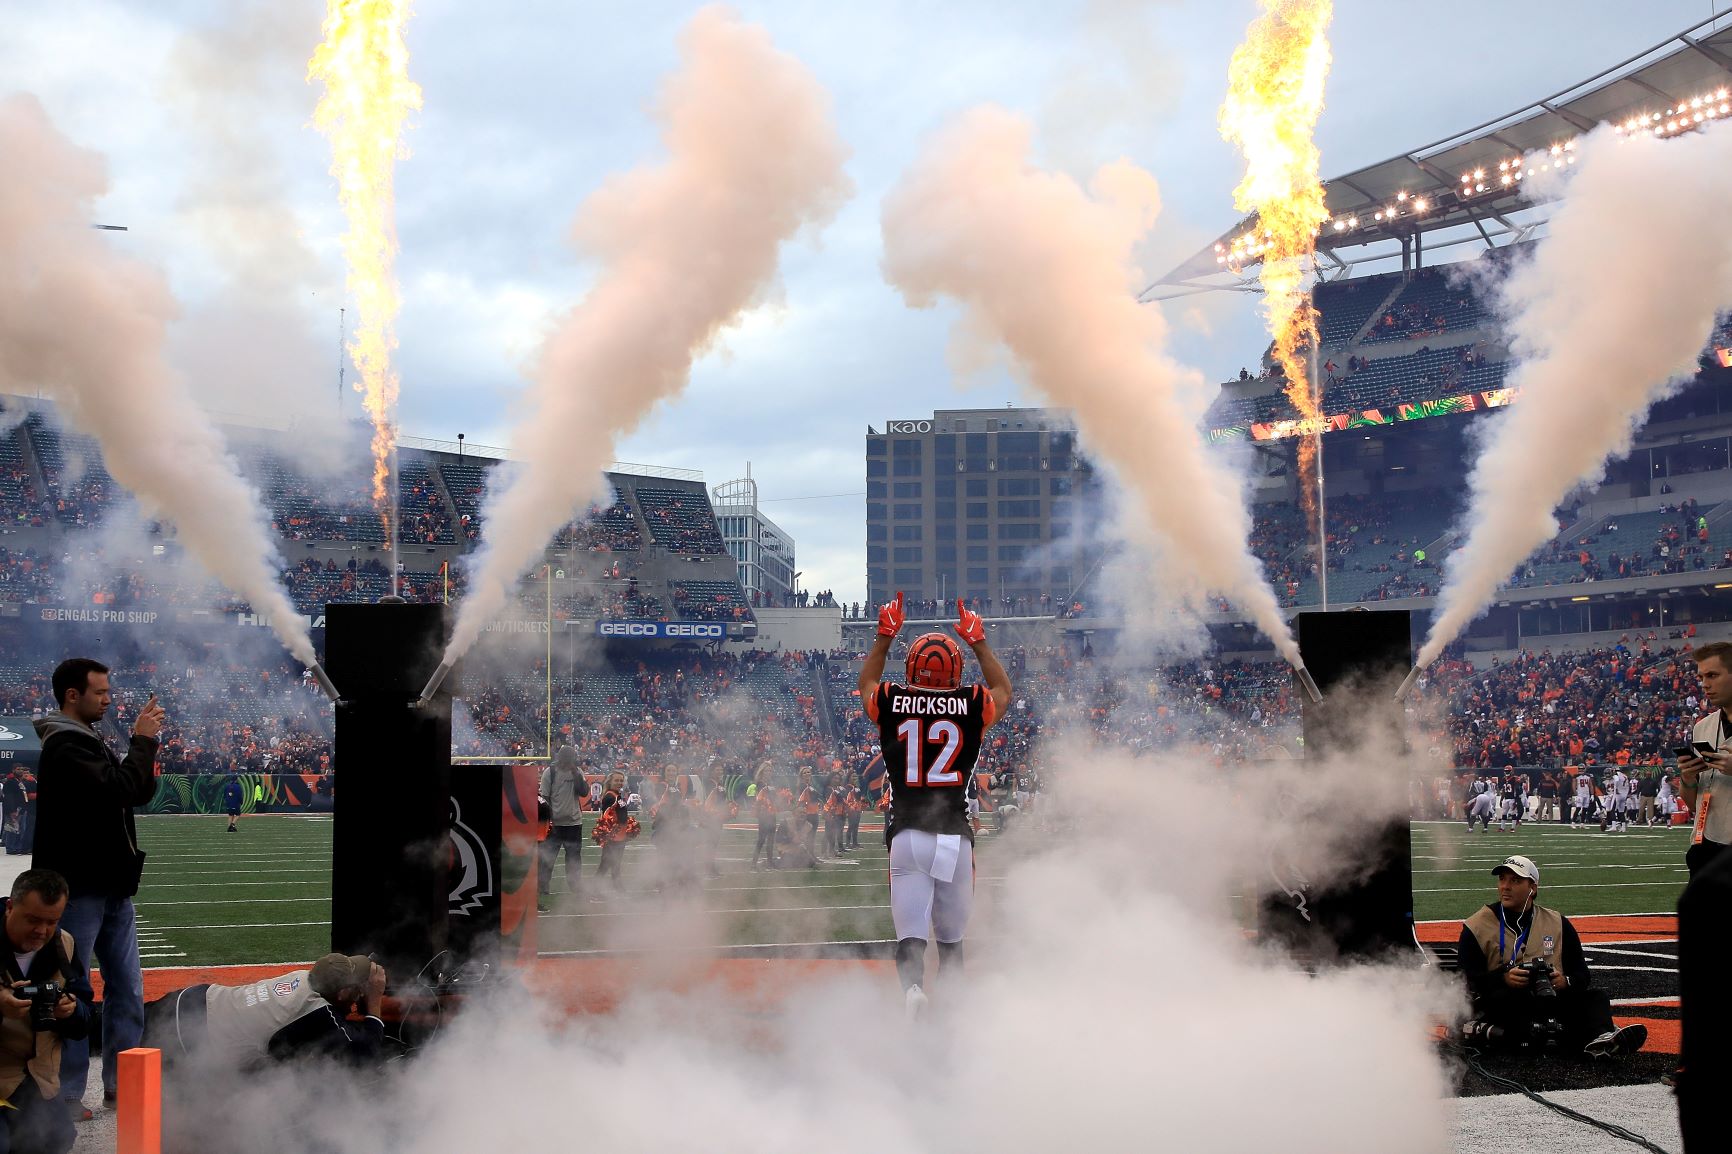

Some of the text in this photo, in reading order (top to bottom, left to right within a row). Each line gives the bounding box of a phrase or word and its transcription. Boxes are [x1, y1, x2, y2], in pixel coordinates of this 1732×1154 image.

[102, 610, 125, 622] PRO
[128, 611, 158, 624] SHOP
[600, 623, 722, 637] GEICO GEICO
[891, 695, 968, 715] ERICKSON
[1, 751, 14, 759] DEY
[897, 718, 964, 787] 12
